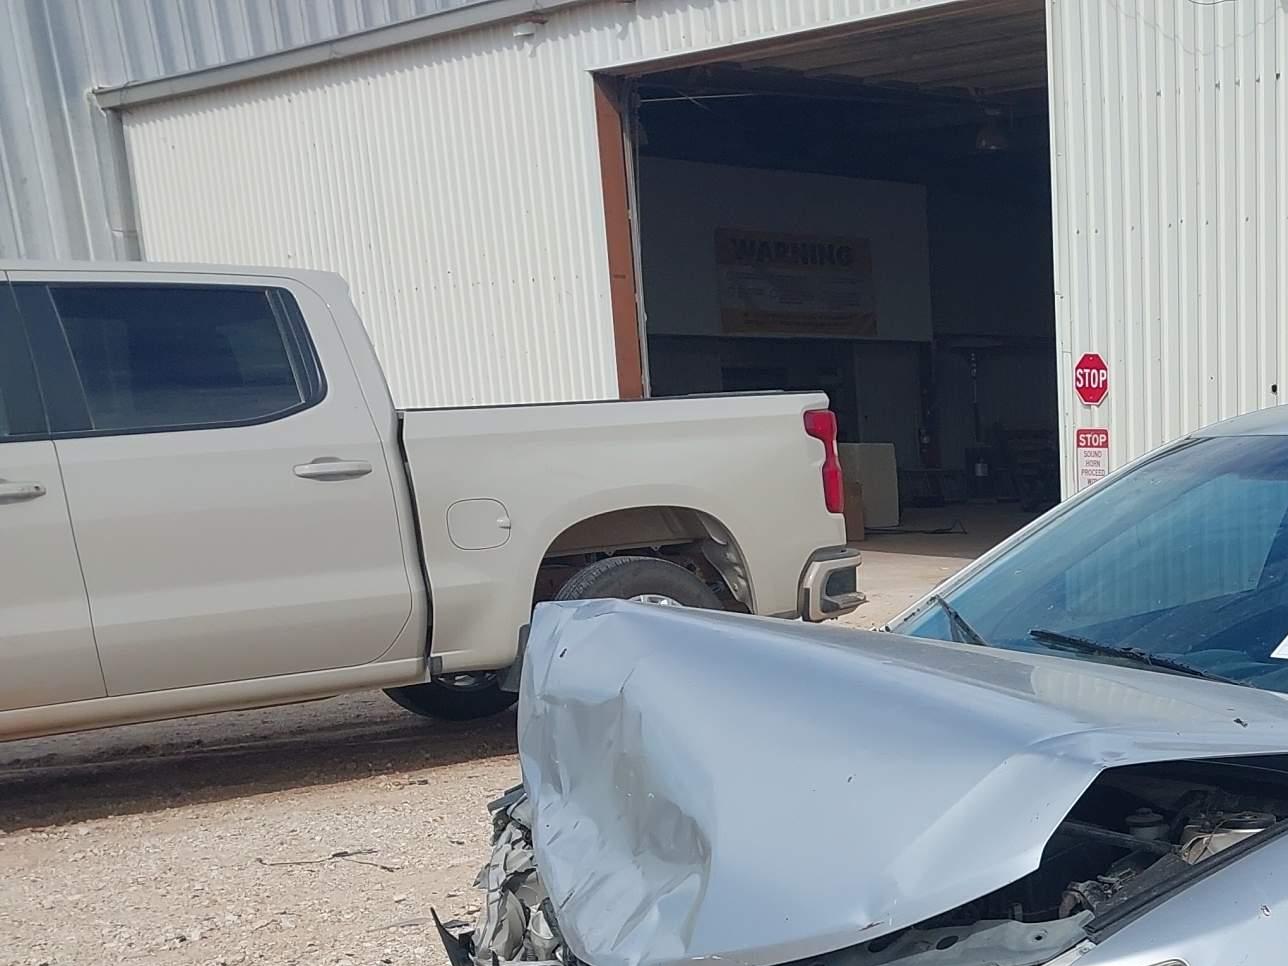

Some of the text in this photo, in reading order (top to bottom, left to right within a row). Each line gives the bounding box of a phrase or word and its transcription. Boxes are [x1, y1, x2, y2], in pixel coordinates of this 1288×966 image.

[729, 239, 853, 266] WARNING
[1076, 369, 1107, 388] STOP
[1079, 434, 1106, 446] STOP
[1081, 469, 1105, 477] PROCEED
